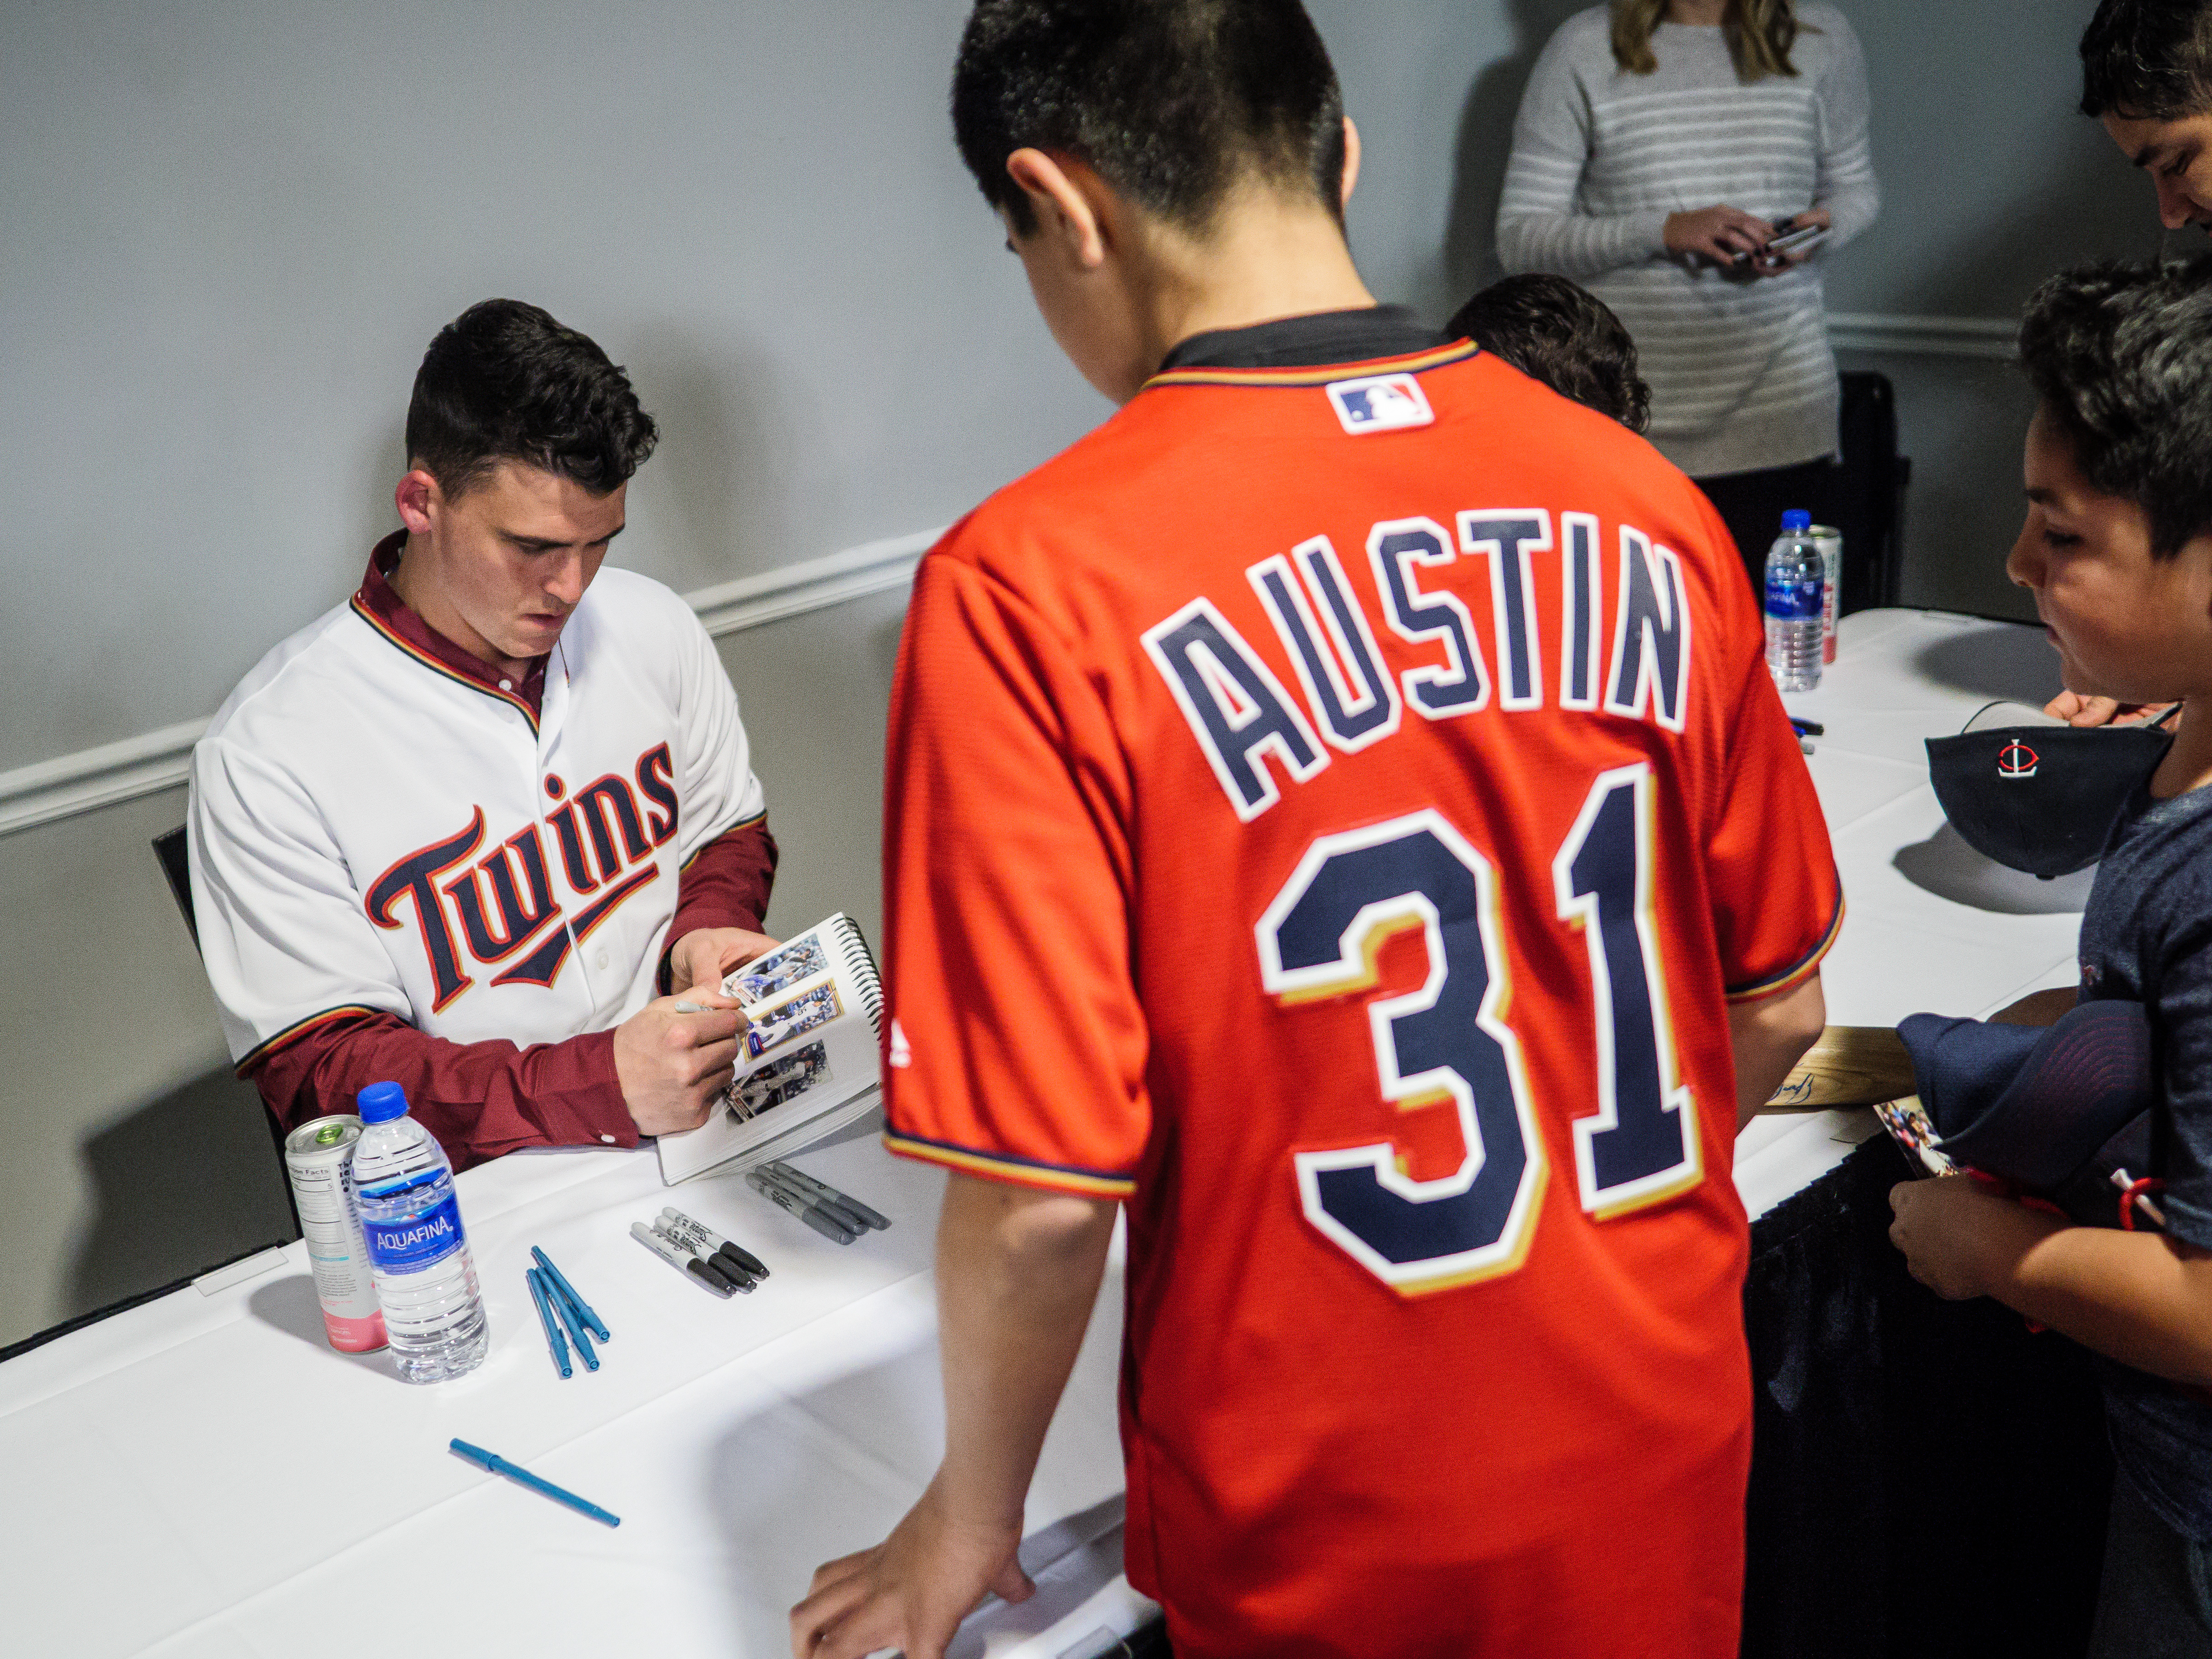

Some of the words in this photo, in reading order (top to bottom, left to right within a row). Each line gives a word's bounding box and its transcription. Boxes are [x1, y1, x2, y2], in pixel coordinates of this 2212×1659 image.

[1140, 508, 1690, 823] AUSTIN
[364, 740, 679, 1015] Twins
[1253, 761, 1705, 1298] 31
[377, 1215, 452, 1250] AQUAFINA
